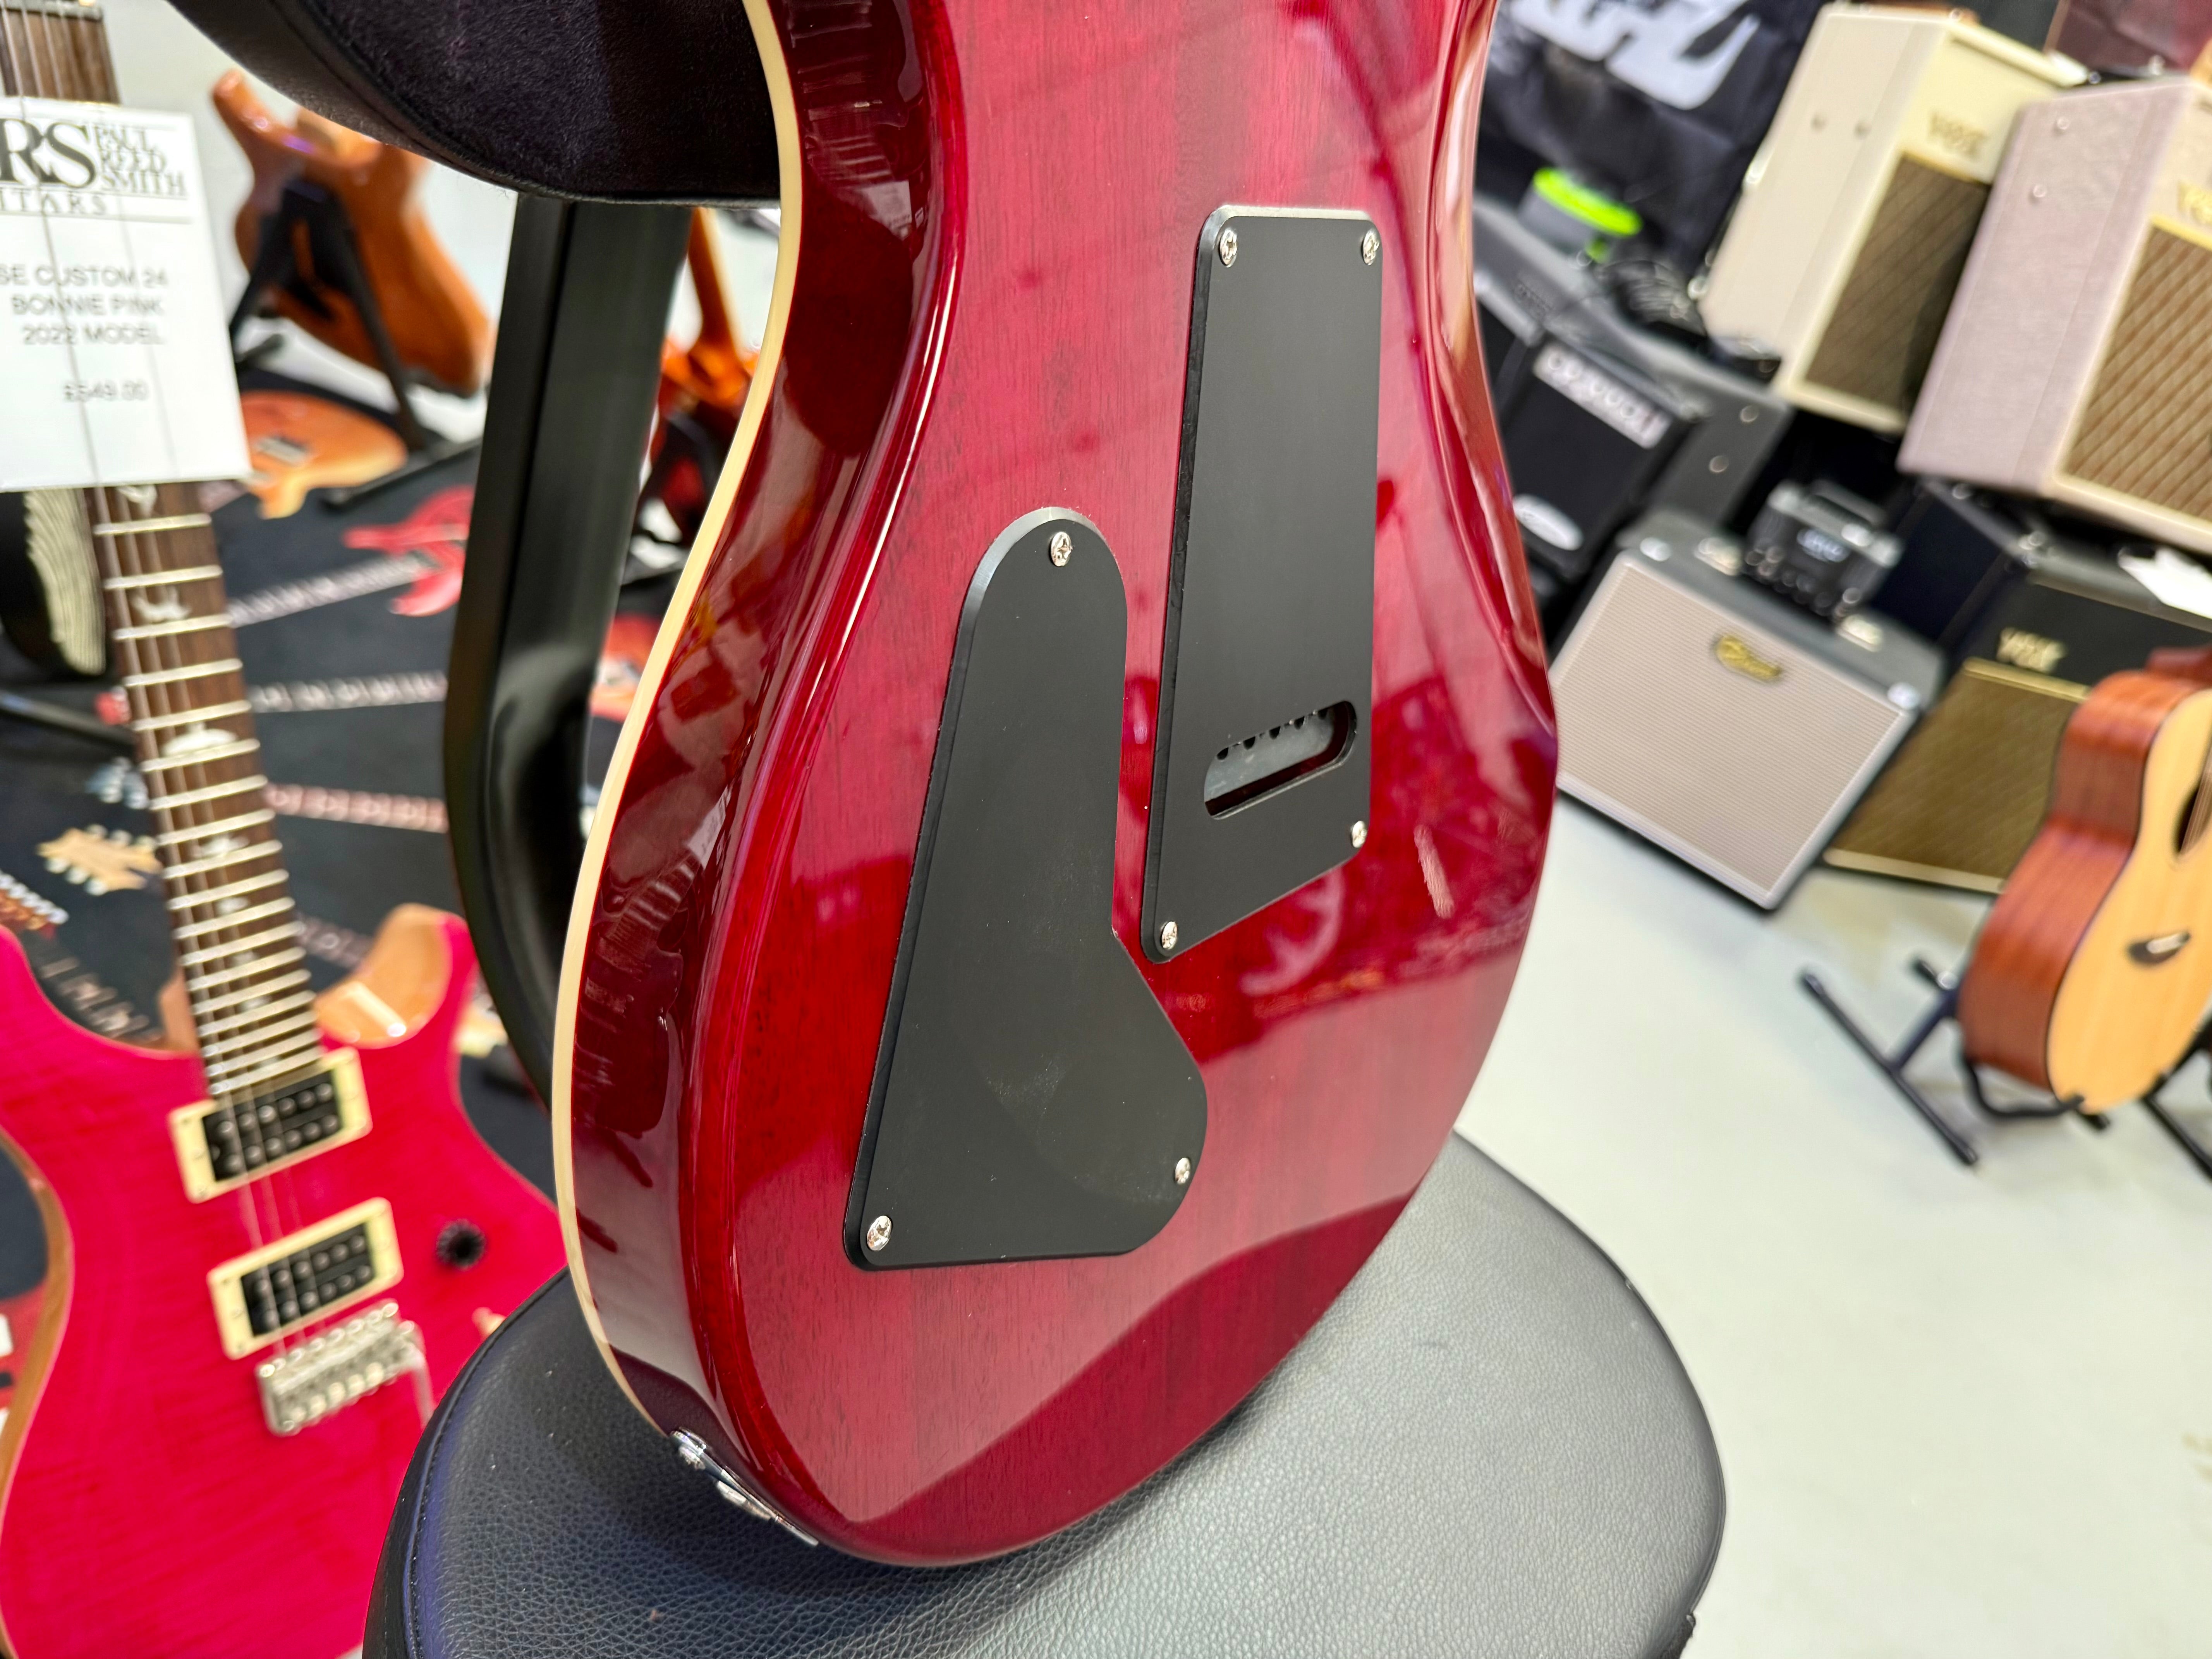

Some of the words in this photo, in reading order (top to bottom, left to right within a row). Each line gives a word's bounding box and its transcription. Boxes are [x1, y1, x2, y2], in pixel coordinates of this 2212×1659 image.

[101, 169, 186, 195] SMITH
[35, 266, 134, 287] CUSTOM
[142, 267, 168, 288] 24
[12, 294, 105, 315] BONNIE
[111, 295, 165, 316] PINK
[23, 323, 76, 345] 2022
[84, 323, 166, 345] MODEL
